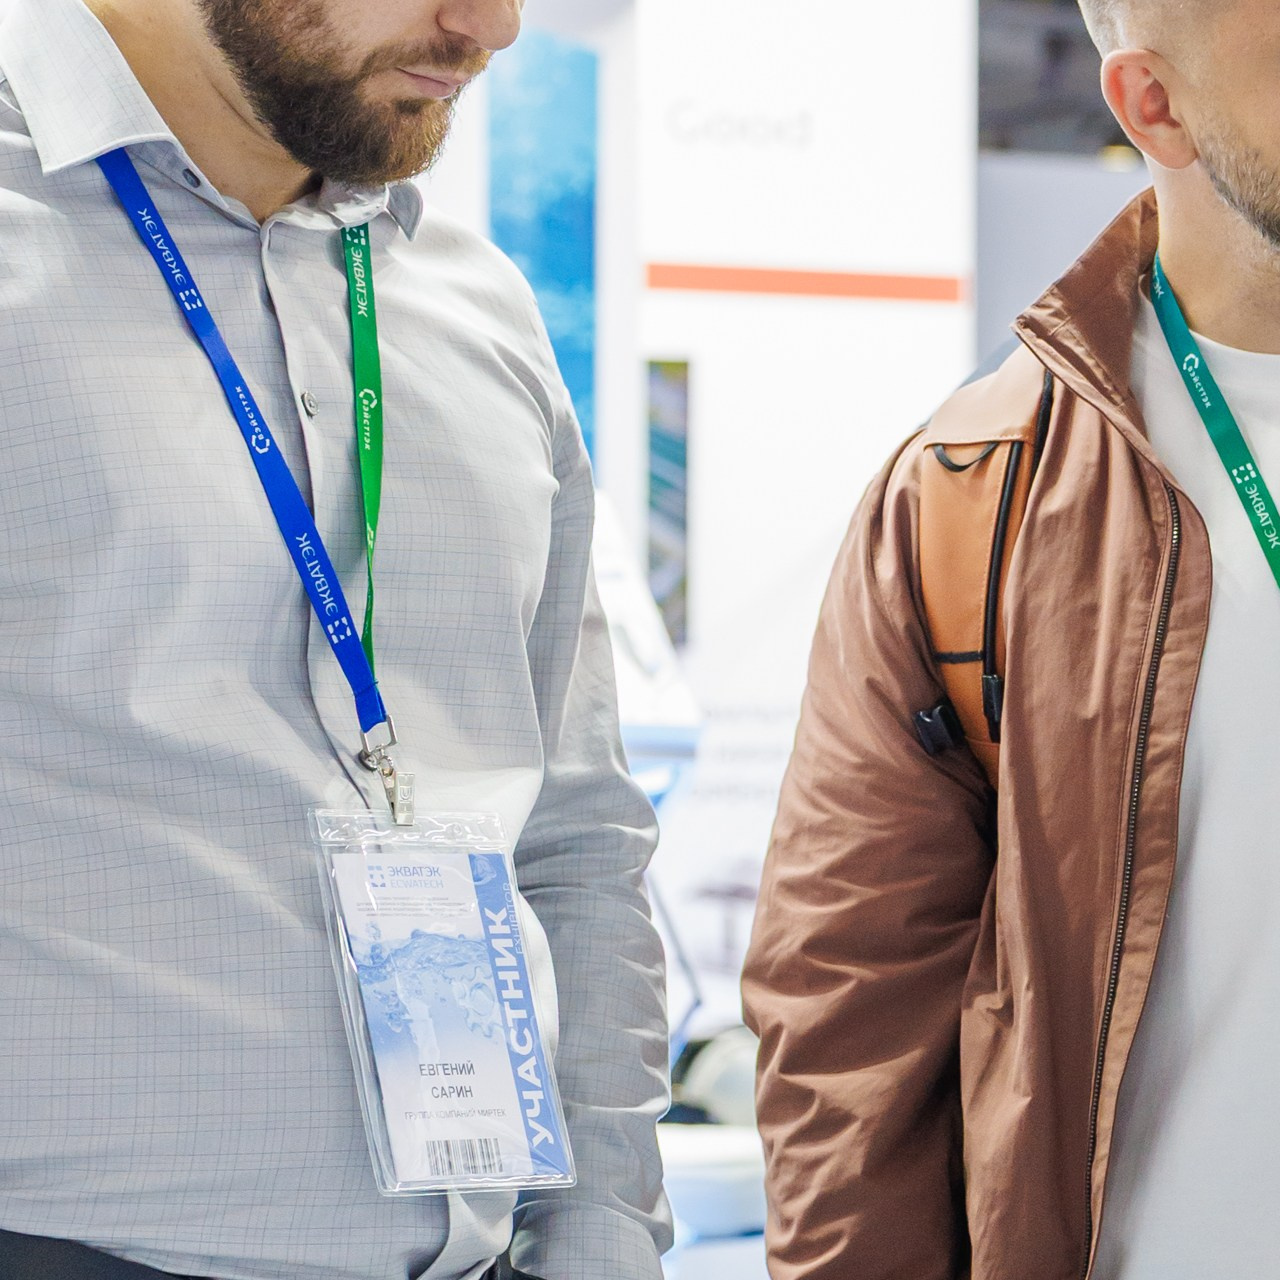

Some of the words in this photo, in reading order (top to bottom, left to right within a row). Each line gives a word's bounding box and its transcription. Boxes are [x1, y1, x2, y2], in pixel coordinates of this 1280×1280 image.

[138, 208, 187, 285] ЭКВАТЭК
[350, 247, 368, 318] ЭКВАТЭК
[296, 533, 338, 616] ЭКВАТЭК
[387, 865, 441, 877] ЭКВАТЭК
[390, 880, 444, 889] ECWATECH
[502, 882, 523, 955] EXHIBITOR
[484, 907, 555, 1148] УЧАСТНИК
[419, 1060, 475, 1076] ЕВГЕНИЙ
[431, 1086, 474, 1098] САРИН
